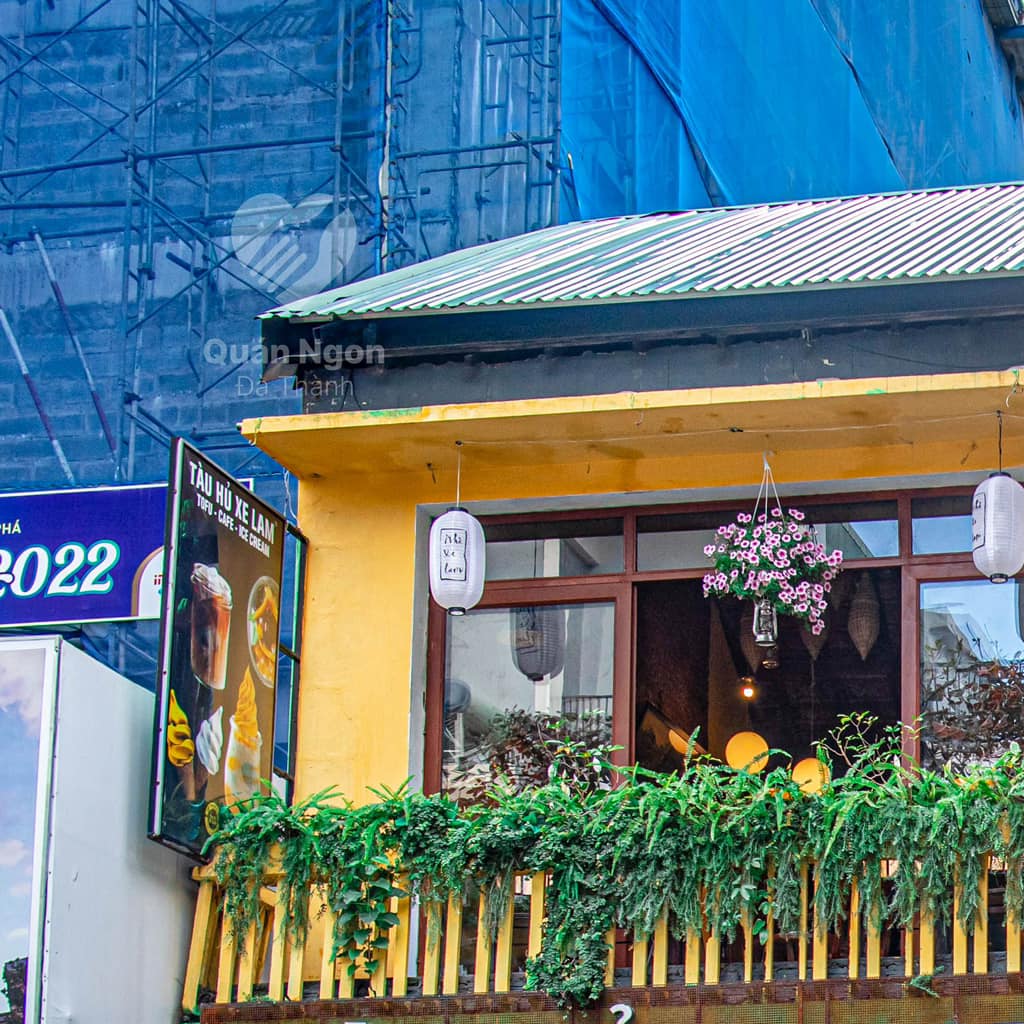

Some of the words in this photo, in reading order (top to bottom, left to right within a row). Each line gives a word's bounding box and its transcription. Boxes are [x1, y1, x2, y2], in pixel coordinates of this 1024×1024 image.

[189, 461, 213, 497] TÀU
[235, 495, 249, 525] XE
[252, 508, 276, 545] LAM
